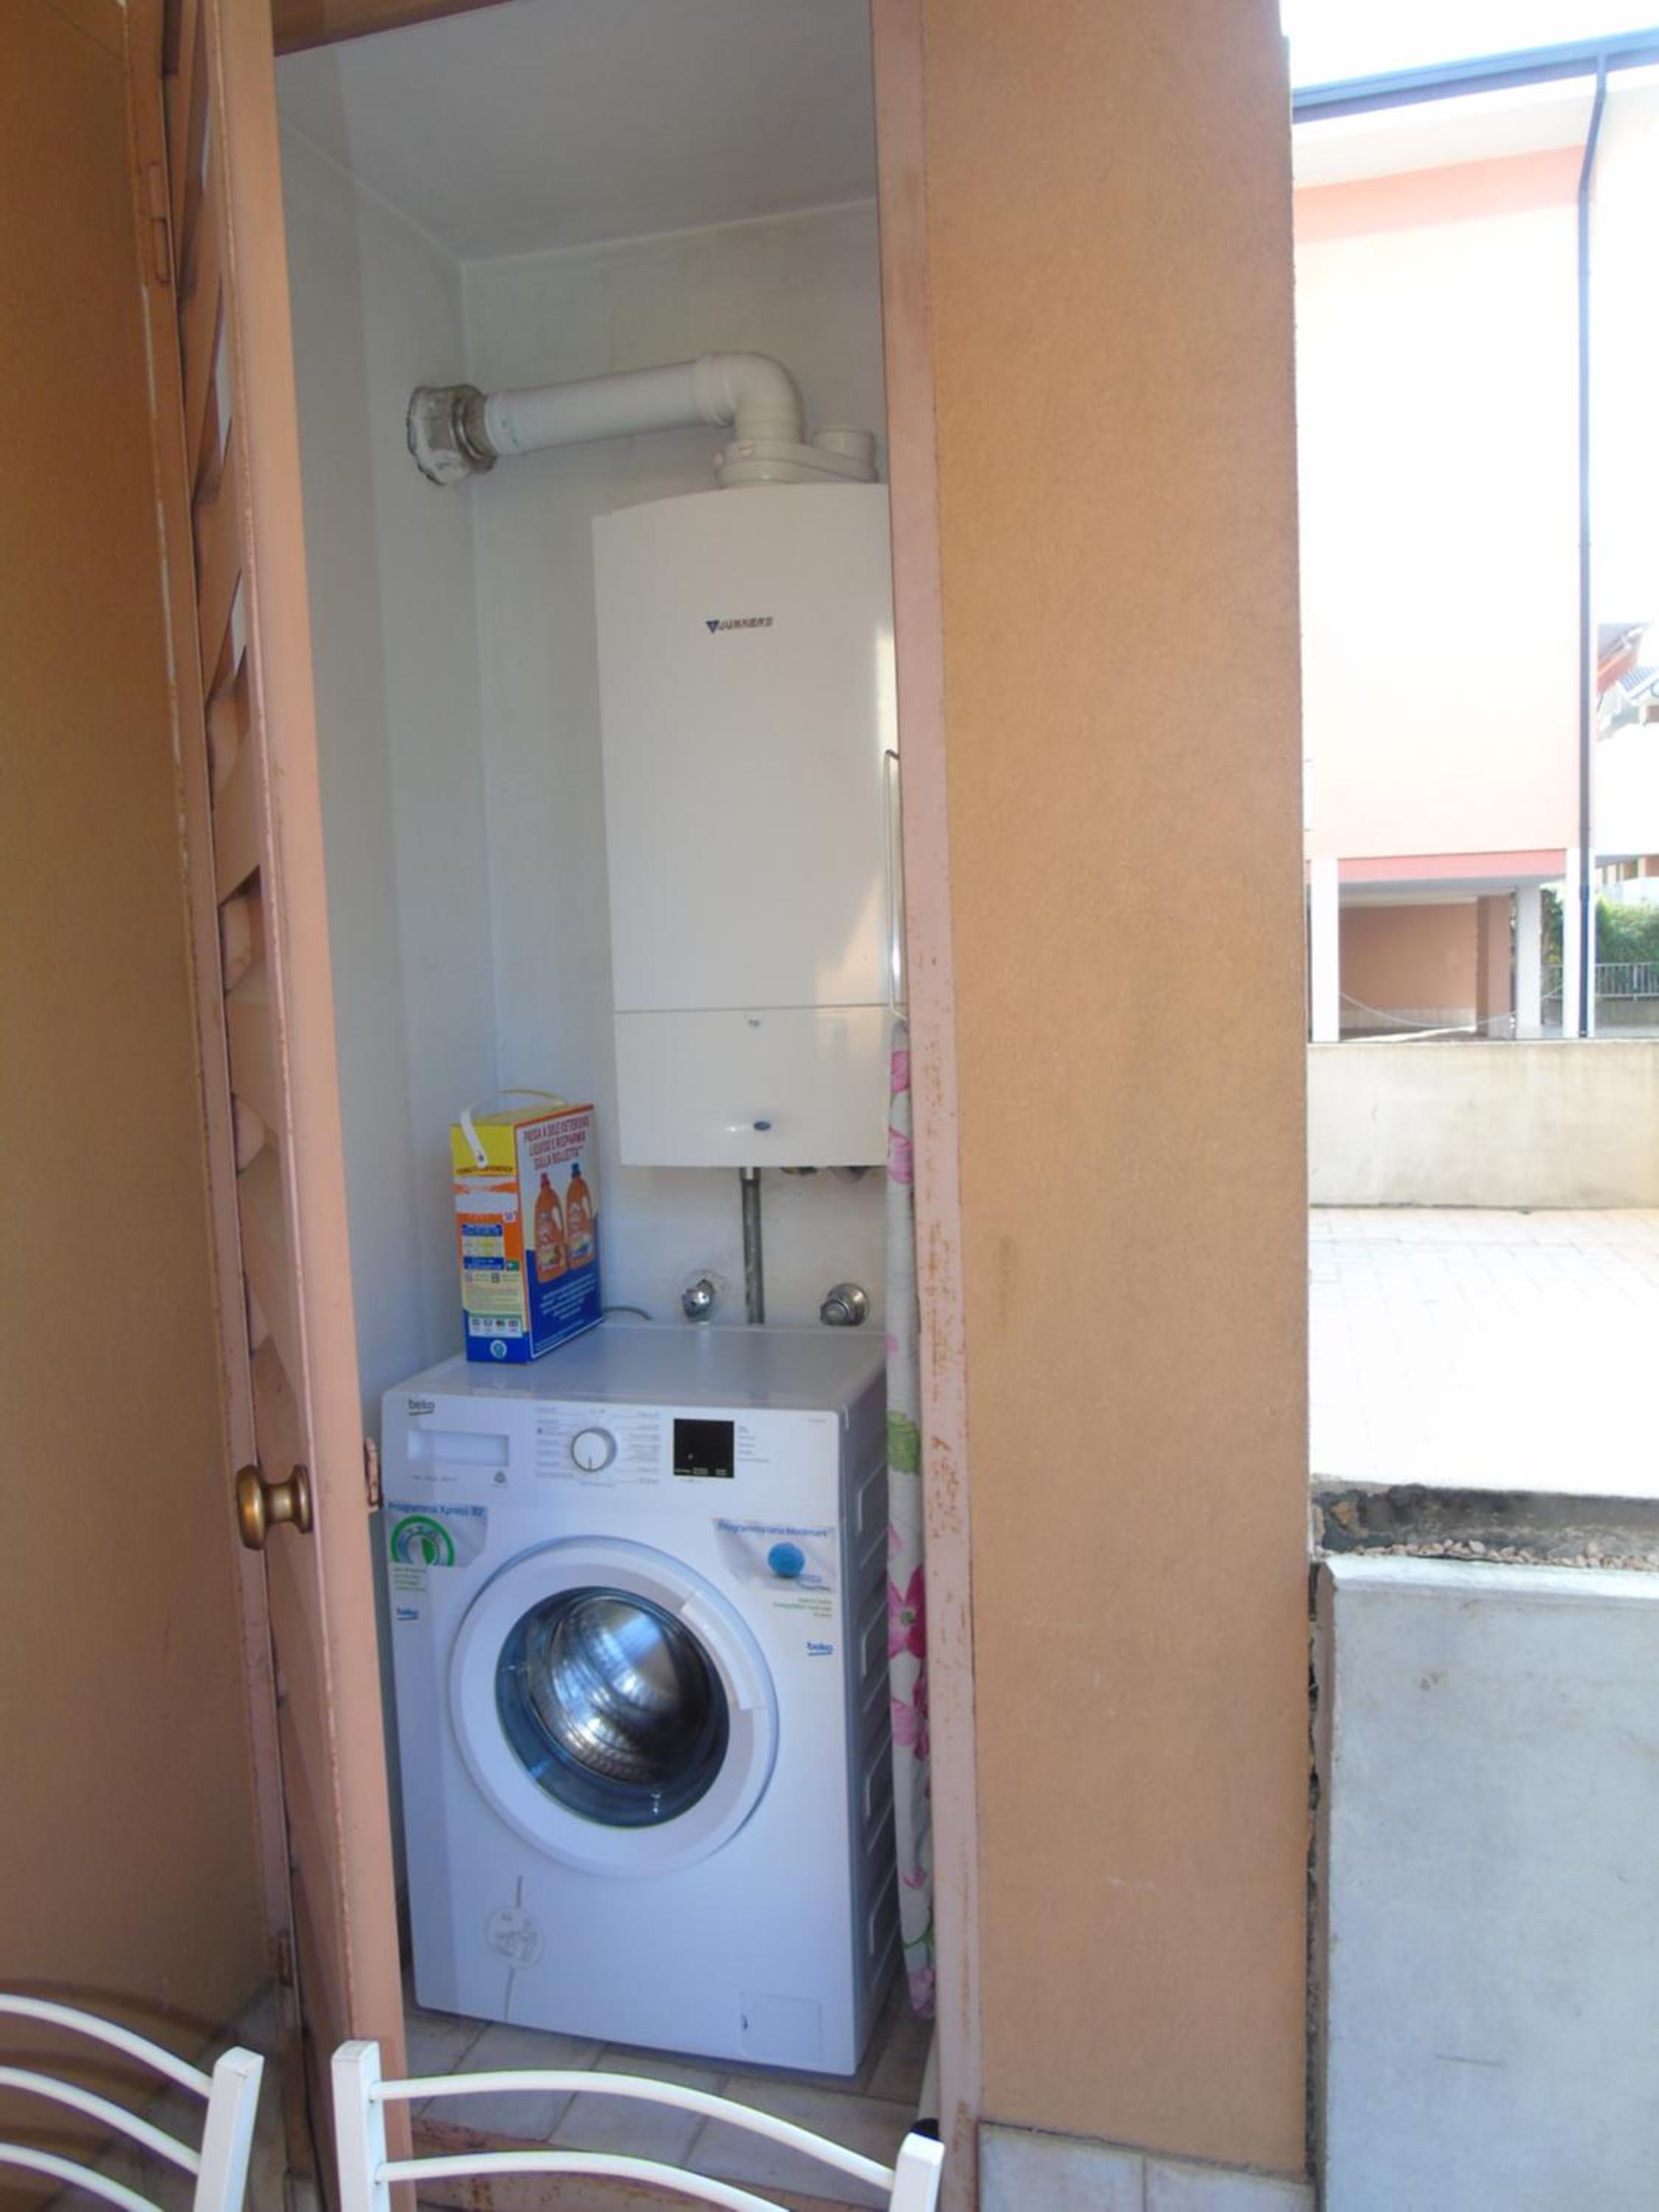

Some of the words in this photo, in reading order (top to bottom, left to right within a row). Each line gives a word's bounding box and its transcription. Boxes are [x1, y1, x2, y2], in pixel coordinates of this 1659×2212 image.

[720, 616, 773, 630] JUNKERS
[408, 1399, 436, 1416] beko
[807, 1641, 833, 1656] beko
